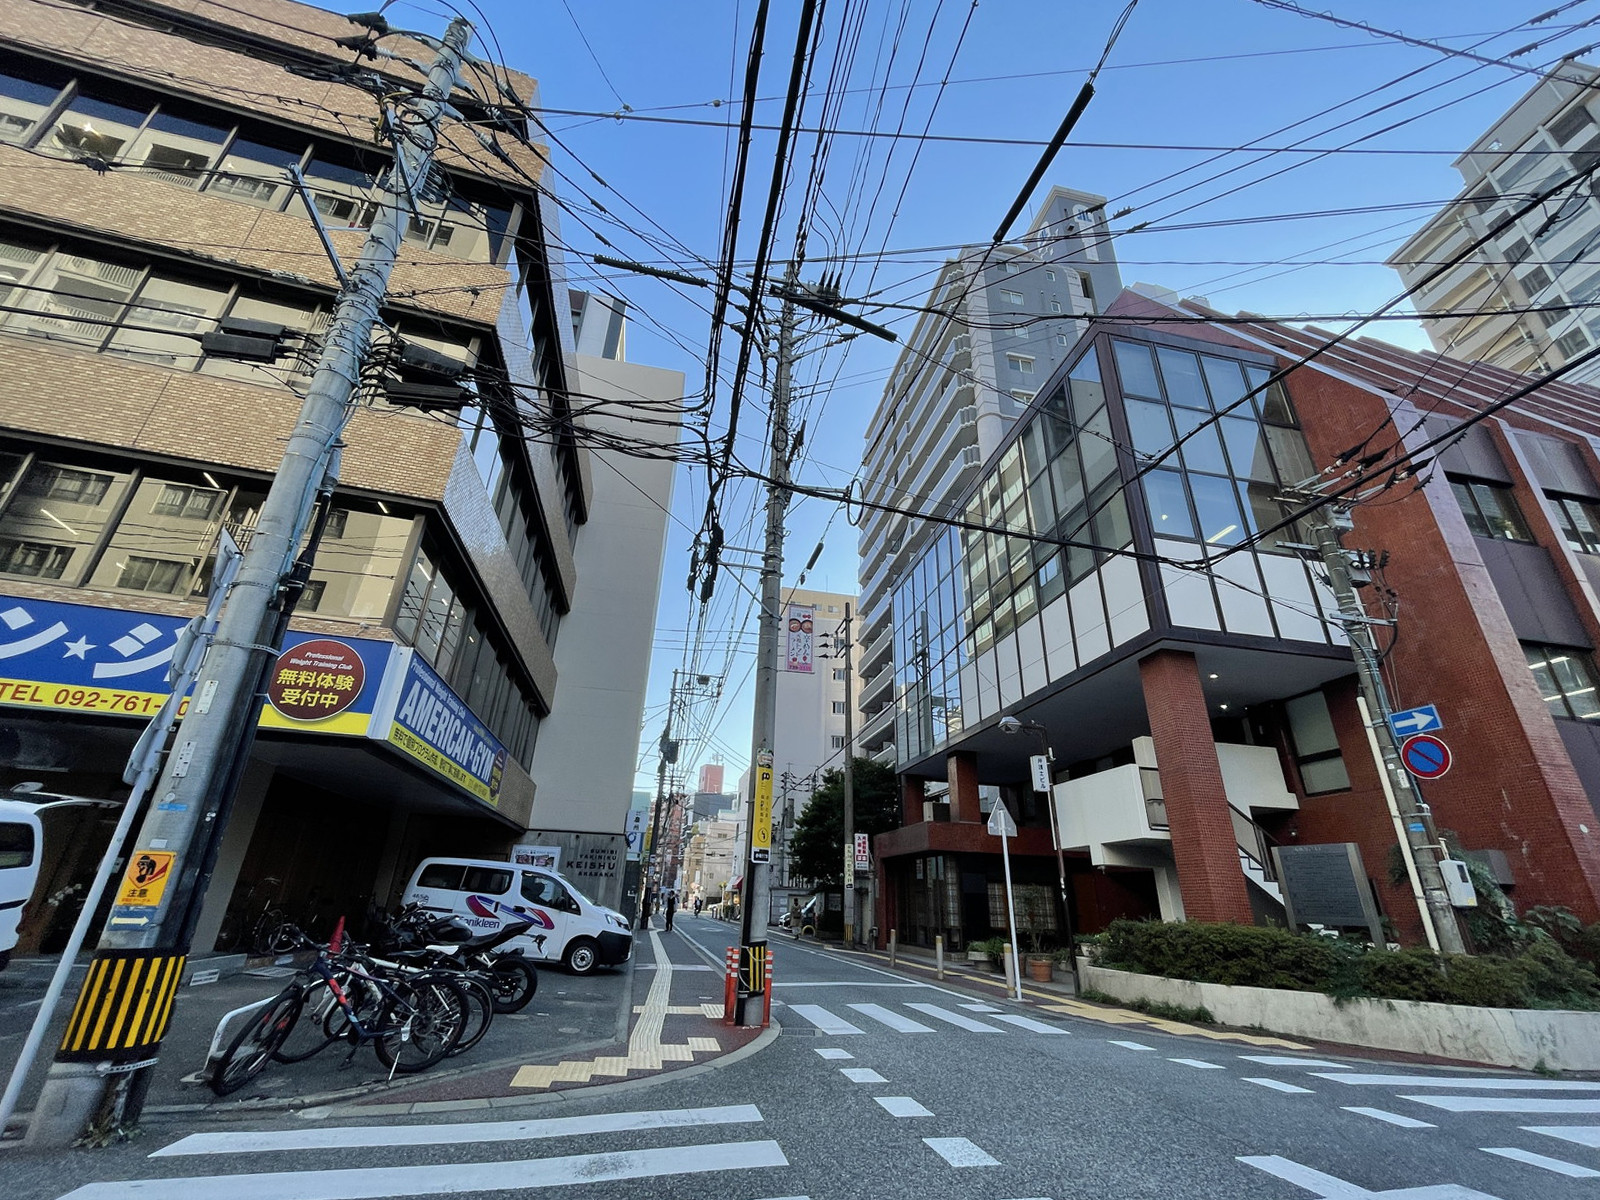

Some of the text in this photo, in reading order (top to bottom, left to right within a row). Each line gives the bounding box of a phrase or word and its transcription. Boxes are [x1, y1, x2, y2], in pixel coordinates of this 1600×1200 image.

[289, 658, 312, 667] Weight
[312, 660, 338, 669] Training
[305, 651, 345, 661] Professional
[276, 668, 355, 691] 無料体験
[0, 682, 43, 702] TEL
[279, 688, 339, 708] 受付中
[399, 680, 475, 766] AMERICAN
[471, 741, 496, 782] GYM
[566, 861, 616, 870] KEISHU
